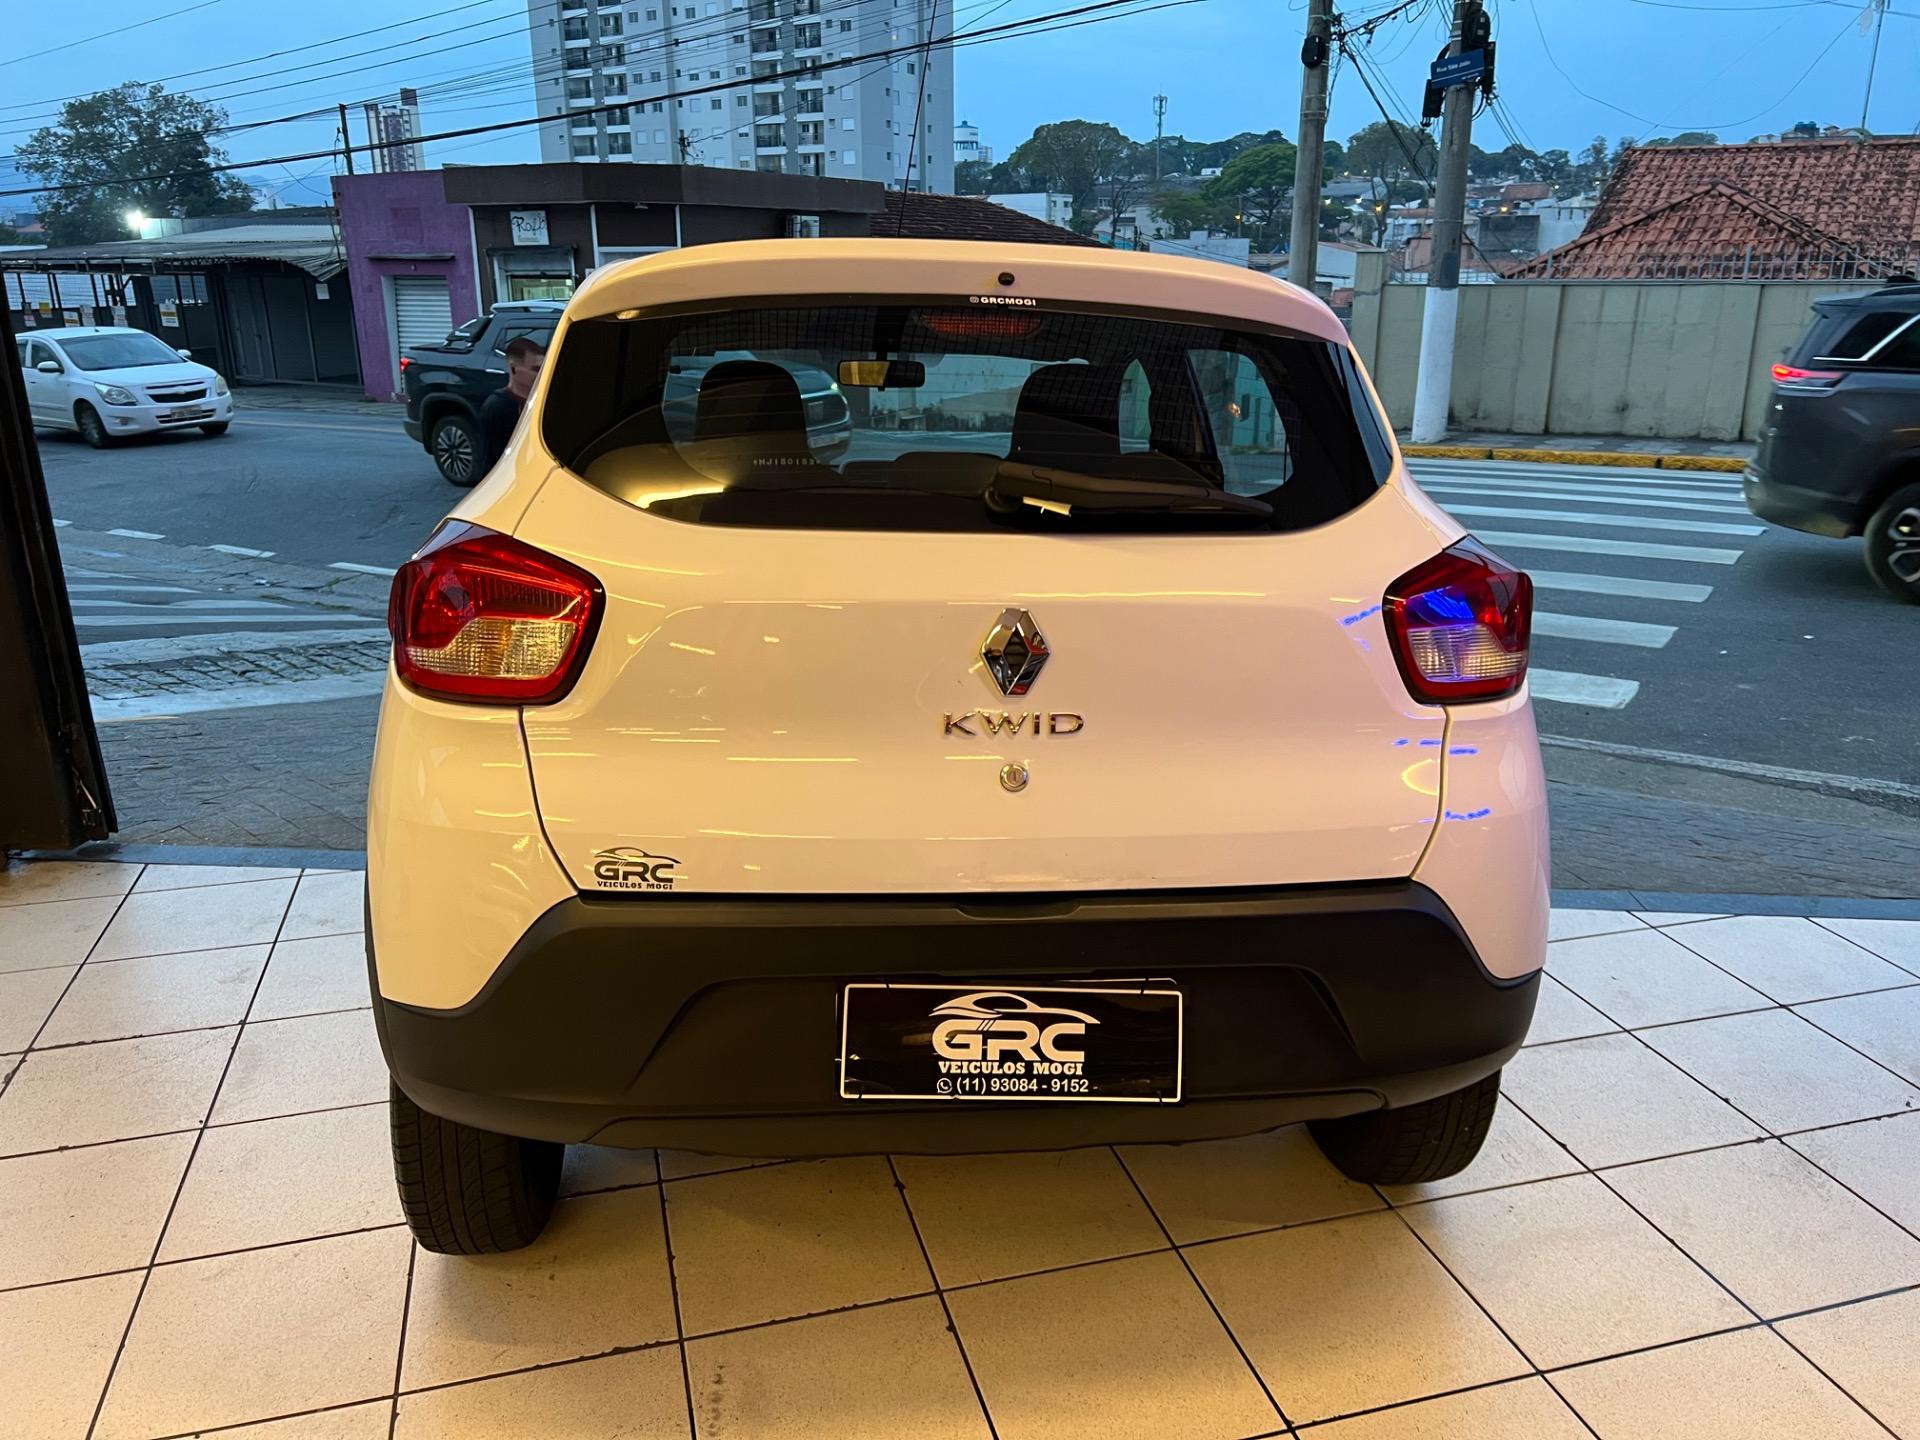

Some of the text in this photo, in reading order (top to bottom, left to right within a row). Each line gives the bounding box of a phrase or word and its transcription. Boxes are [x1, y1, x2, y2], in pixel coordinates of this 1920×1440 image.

[943, 711, 1085, 736] KWID
[594, 860, 674, 883] GRC
[597, 881, 642, 889] VEICULOS
[932, 1018, 1086, 1063] GRC
[938, 1061, 1083, 1075] VEICULOS MOGI
[956, 1076, 987, 1095] (11)
[990, 1077, 1039, 1093] 93084
[1050, 1078, 1089, 1093] 9152
